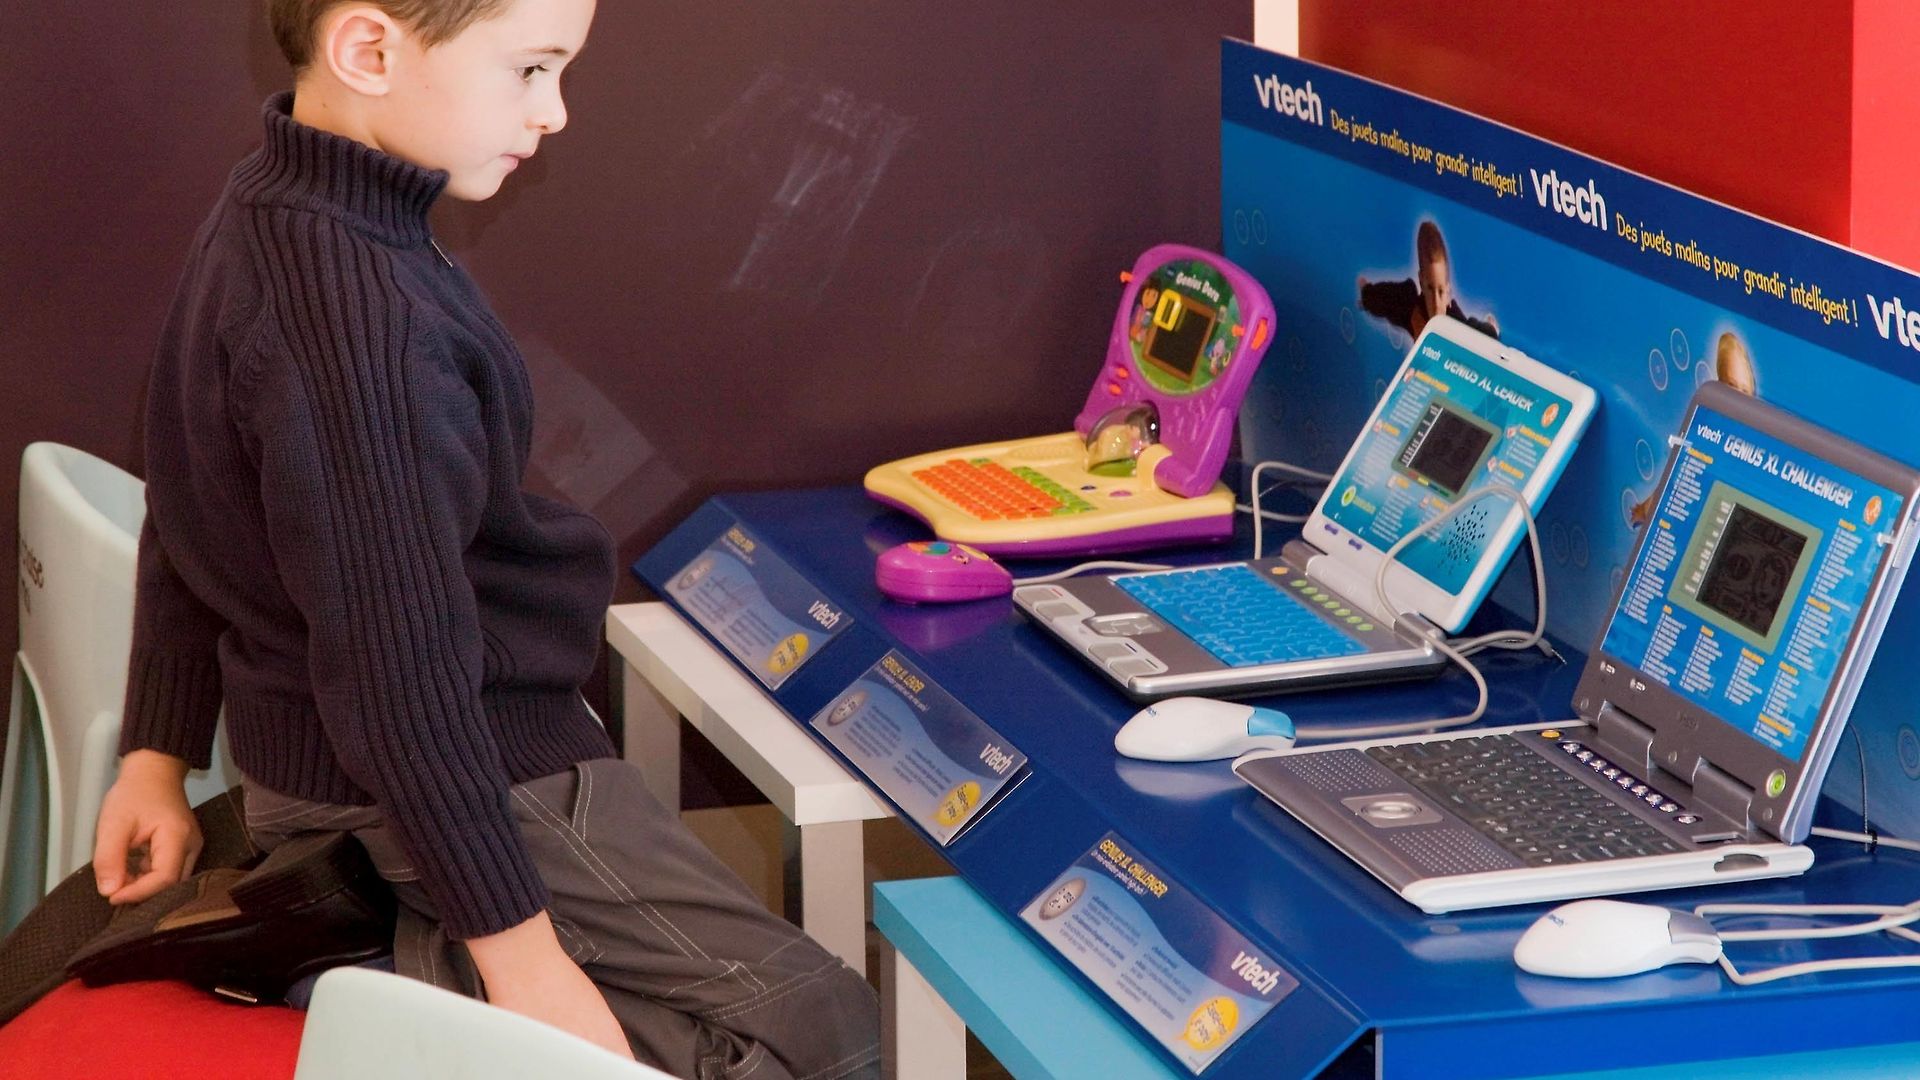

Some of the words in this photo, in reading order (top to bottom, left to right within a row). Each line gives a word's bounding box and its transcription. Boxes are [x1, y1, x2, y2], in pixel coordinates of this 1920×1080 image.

[1253, 74, 1323, 126] vtech
[1331, 108, 1349, 134] Des
[1352, 116, 1378, 144] jouets
[1381, 129, 1409, 156] malins
[1412, 142, 1432, 164] pour
[1436, 152, 1469, 177] grandir
[1472, 158, 1517, 197] intelligent
[1530, 168, 1608, 231] vtech
[1176, 271, 1202, 291] Genius
[1616, 211, 1638, 243] Des
[1640, 222, 1672, 256] jouets
[1675, 240, 1711, 271] malins
[1714, 256, 1740, 281] pour
[1744, 267, 1786, 299] grandir
[1790, 278, 1850, 325] intelligent
[1853, 299, 1859, 328] !
[1443, 359, 1479, 384] GENIUS
[1478, 375, 1492, 392] XL
[1494, 384, 1534, 412] LEADER
[1697, 423, 1722, 444] vtech
[1723, 434, 1766, 468] GENIUS
[1762, 453, 1780, 475] XL
[1781, 460, 1854, 509] CHALLENGER
[807, 600, 842, 630] vtech
[979, 743, 1014, 775] vtech
[1231, 951, 1281, 996] vtech
